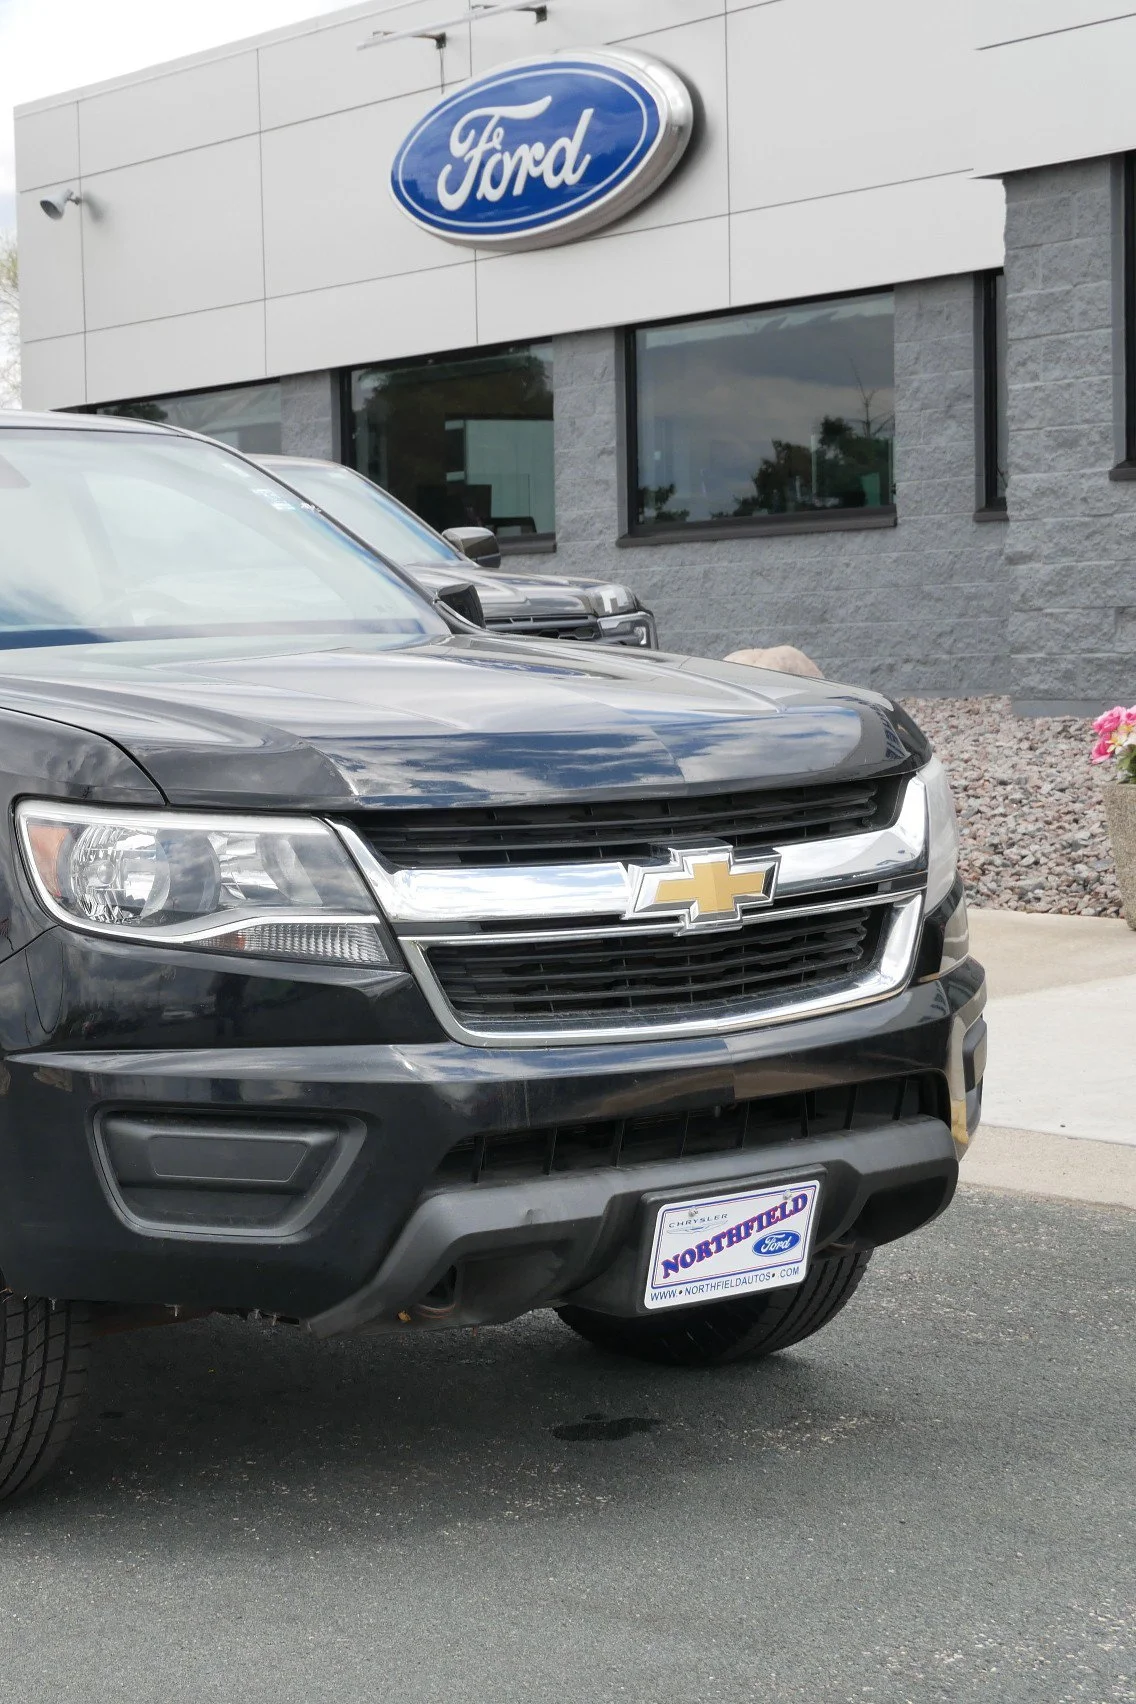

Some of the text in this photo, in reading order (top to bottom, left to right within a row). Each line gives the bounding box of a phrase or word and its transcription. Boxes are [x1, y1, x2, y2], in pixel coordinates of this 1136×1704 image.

[437, 95, 594, 211] Ford
[660, 1192, 809, 1280] NORTHFIELD
[668, 1213, 728, 1229] CHRYSLER
[760, 1233, 792, 1256] Ford
